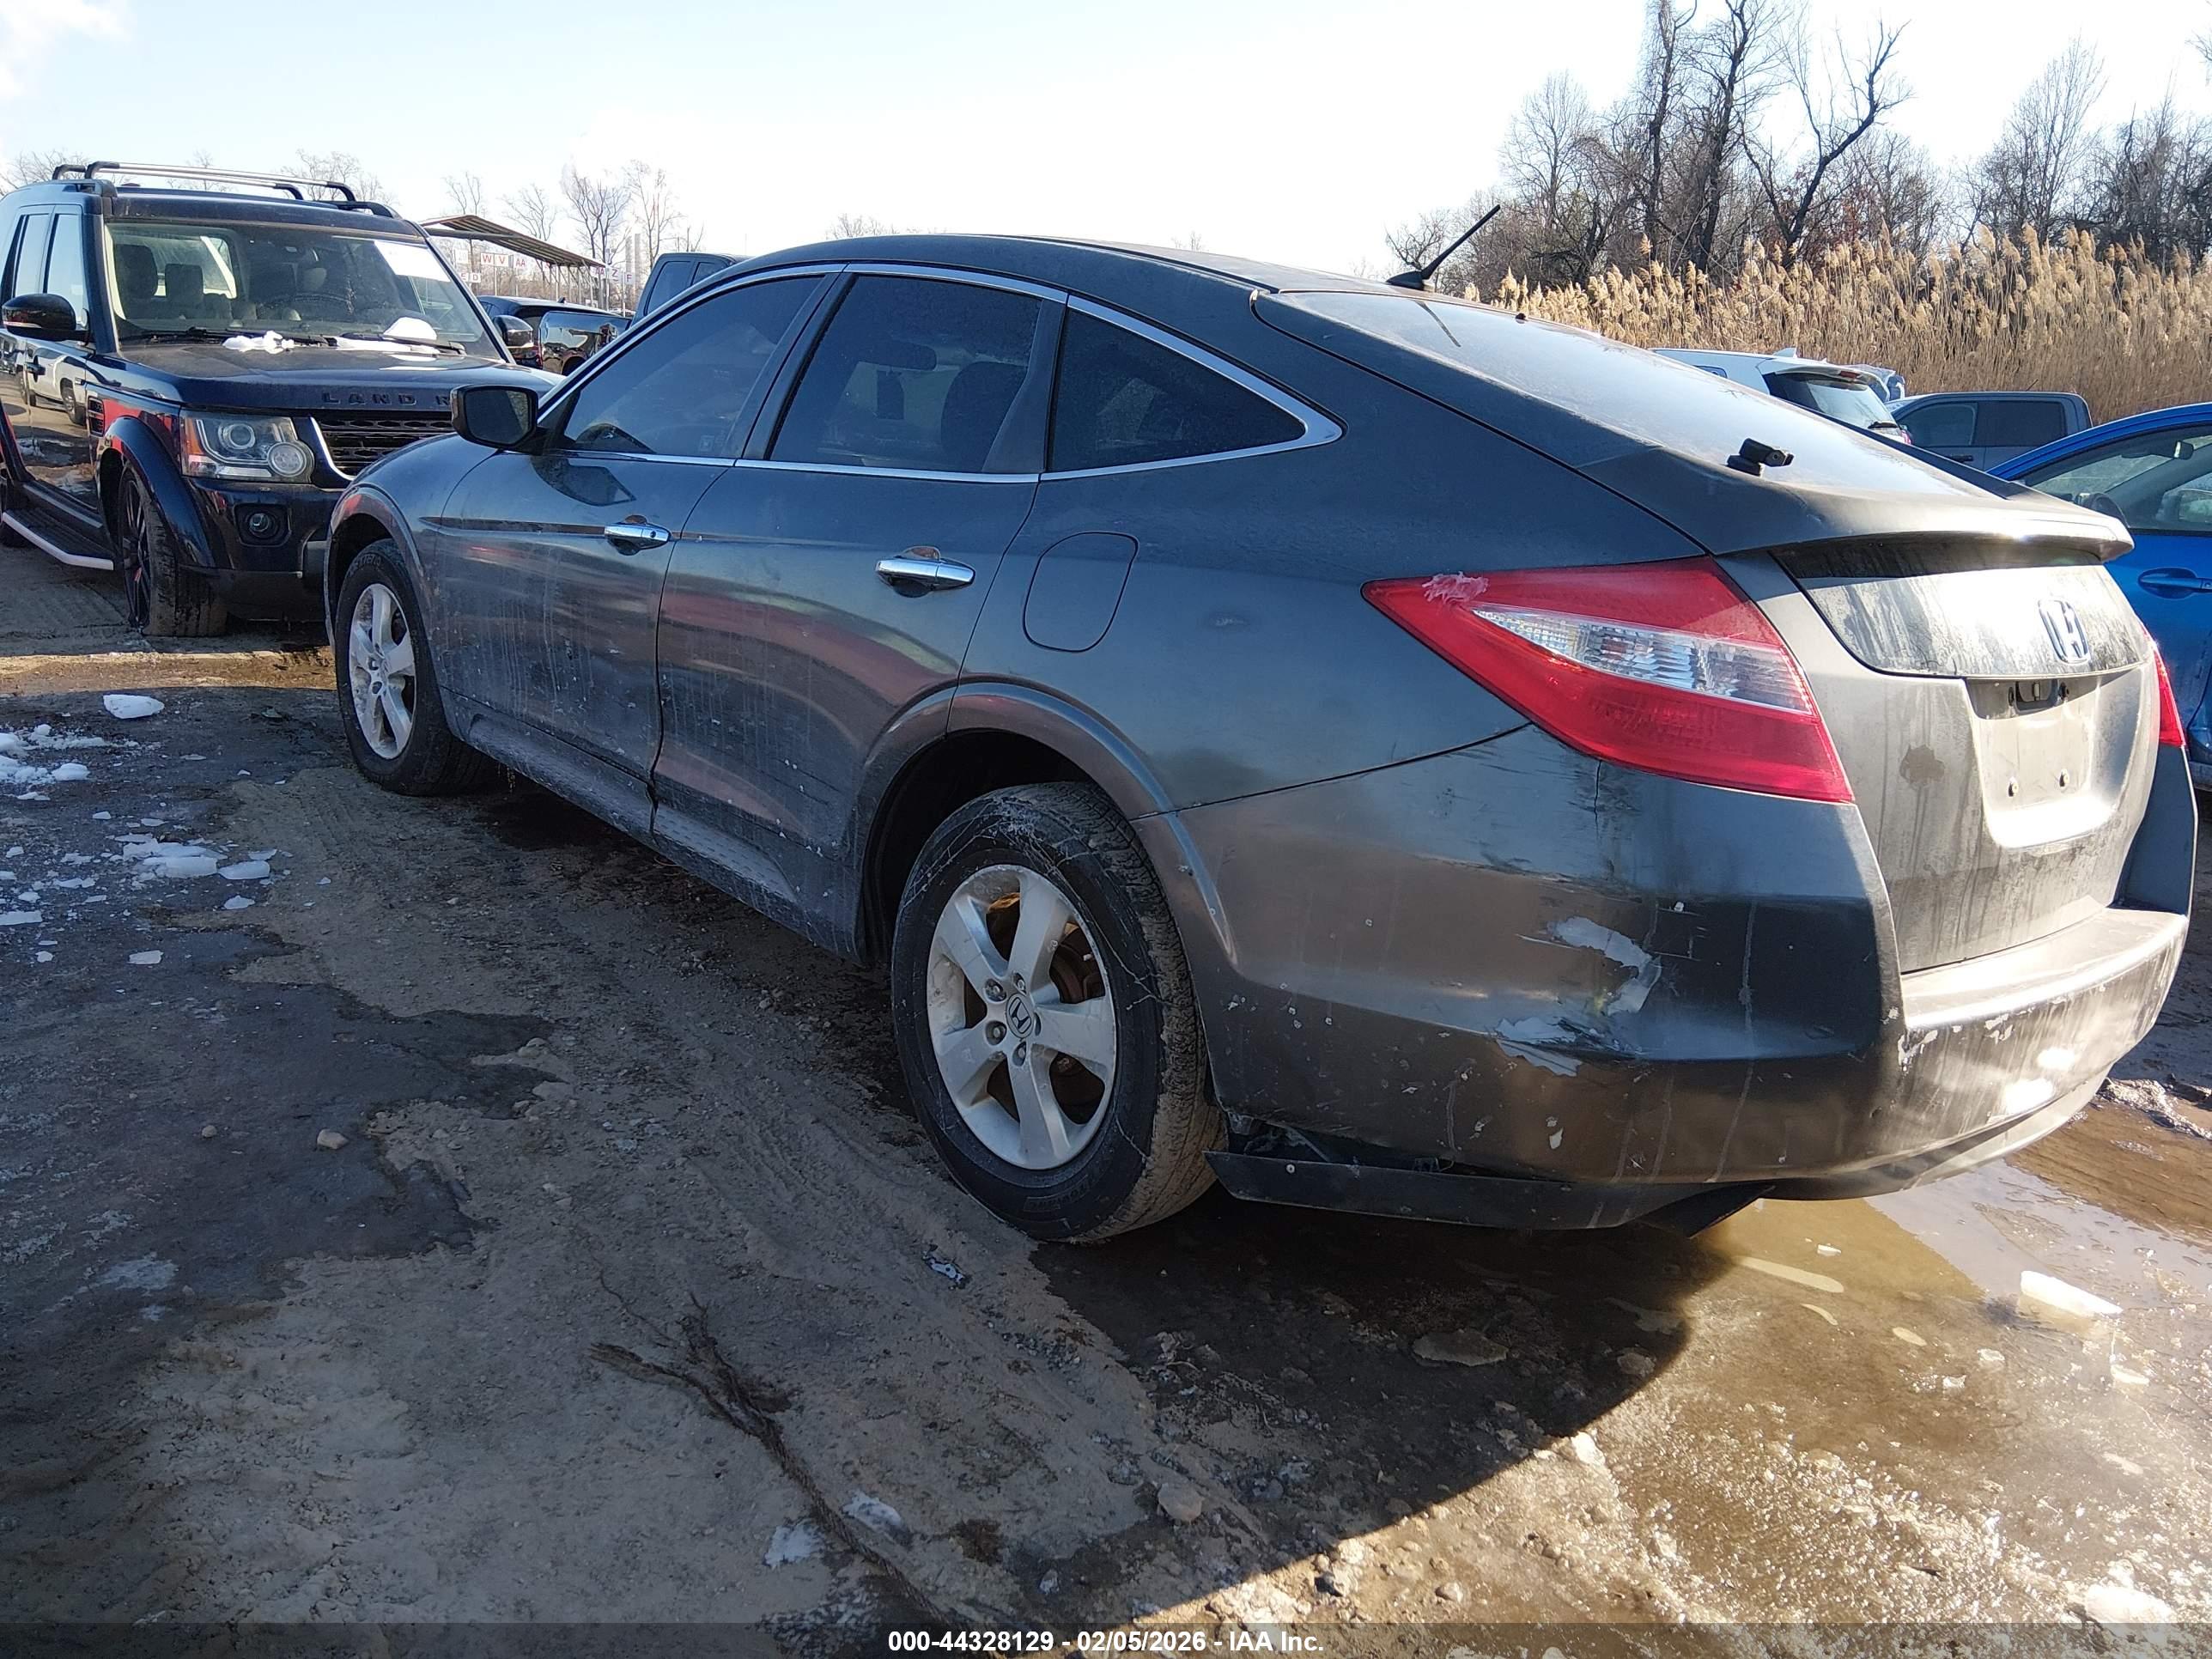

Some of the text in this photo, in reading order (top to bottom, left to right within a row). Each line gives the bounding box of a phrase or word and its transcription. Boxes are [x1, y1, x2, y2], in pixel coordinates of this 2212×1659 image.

[482, 253, 492, 263] W
[498, 255, 506, 264] V
[515, 258, 526, 267] AA
[321, 392, 417, 406] LAND
